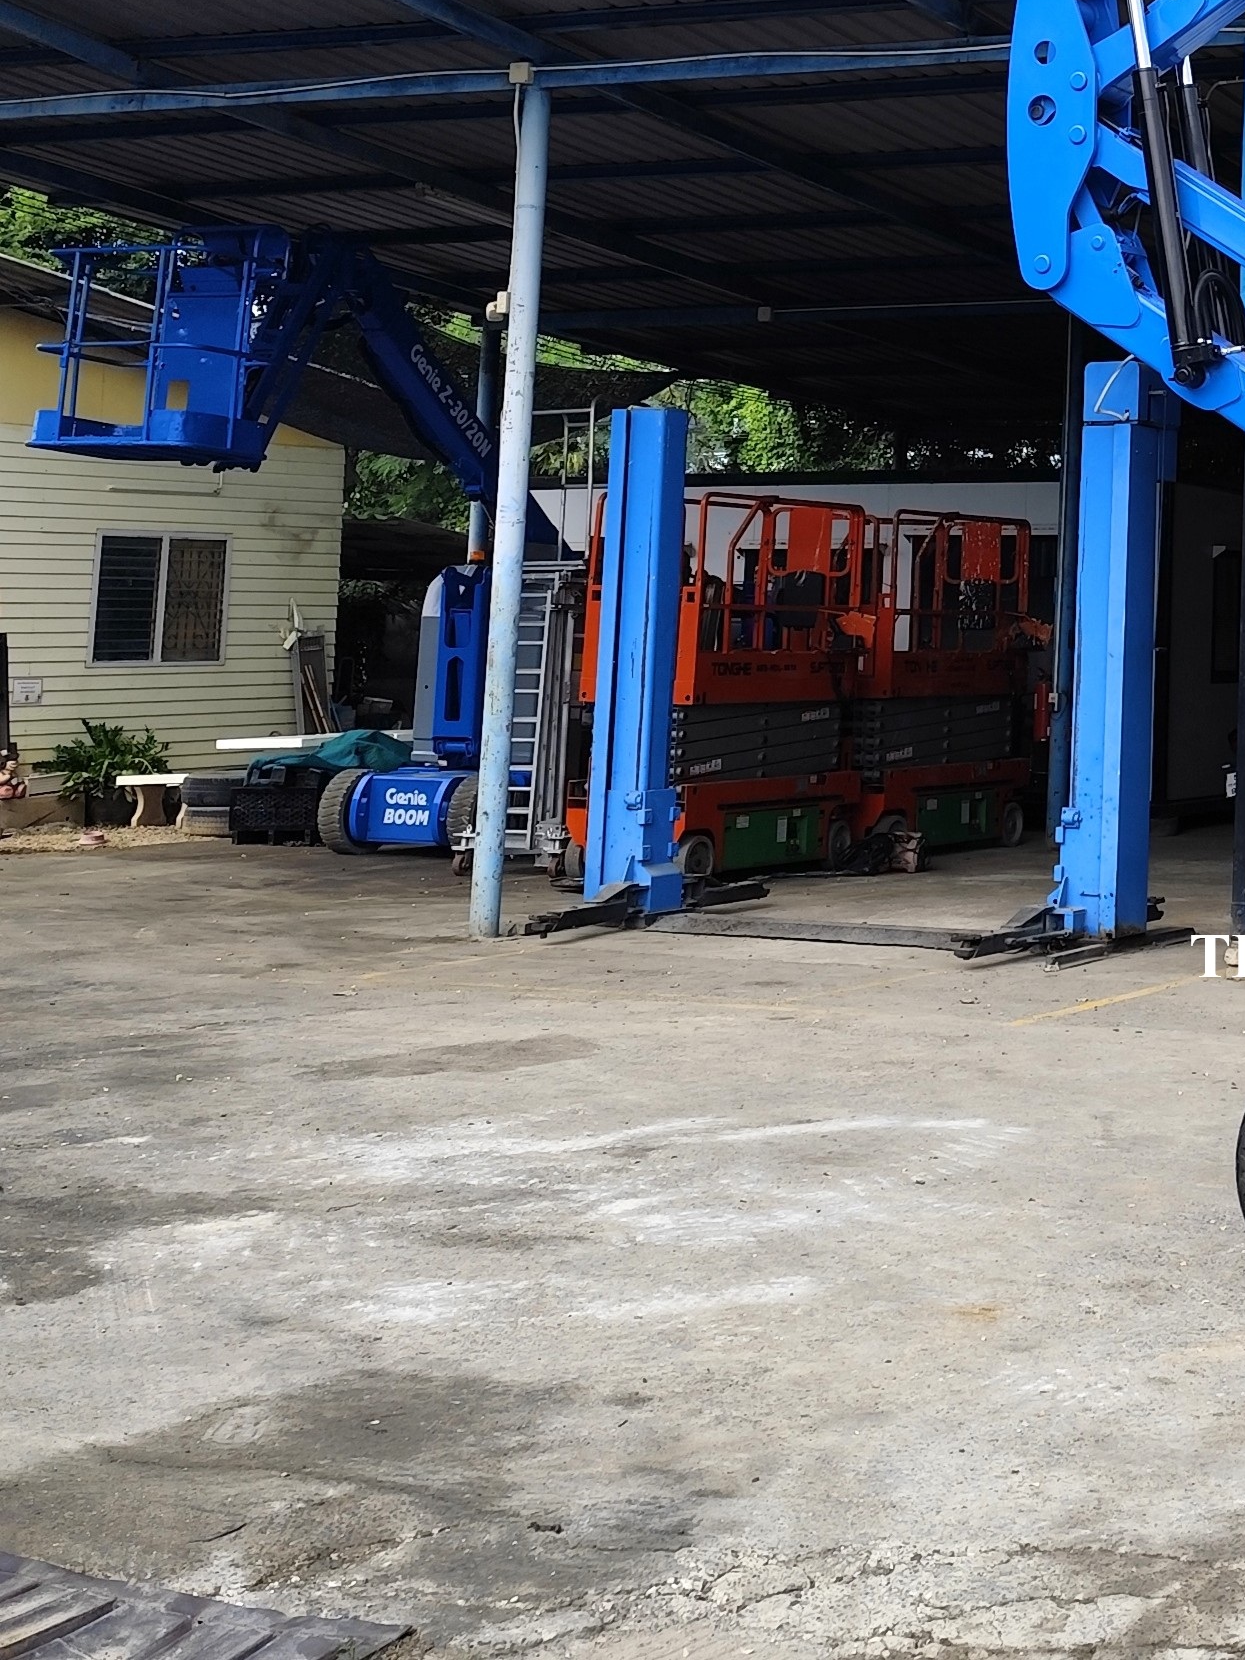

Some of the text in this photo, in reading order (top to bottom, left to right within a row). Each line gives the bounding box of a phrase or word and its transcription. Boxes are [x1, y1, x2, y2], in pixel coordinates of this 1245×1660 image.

[410, 344, 493, 458] Genie Z-30/20N
[386, 787, 427, 806] Genie
[383, 808, 430, 826] BOOM
